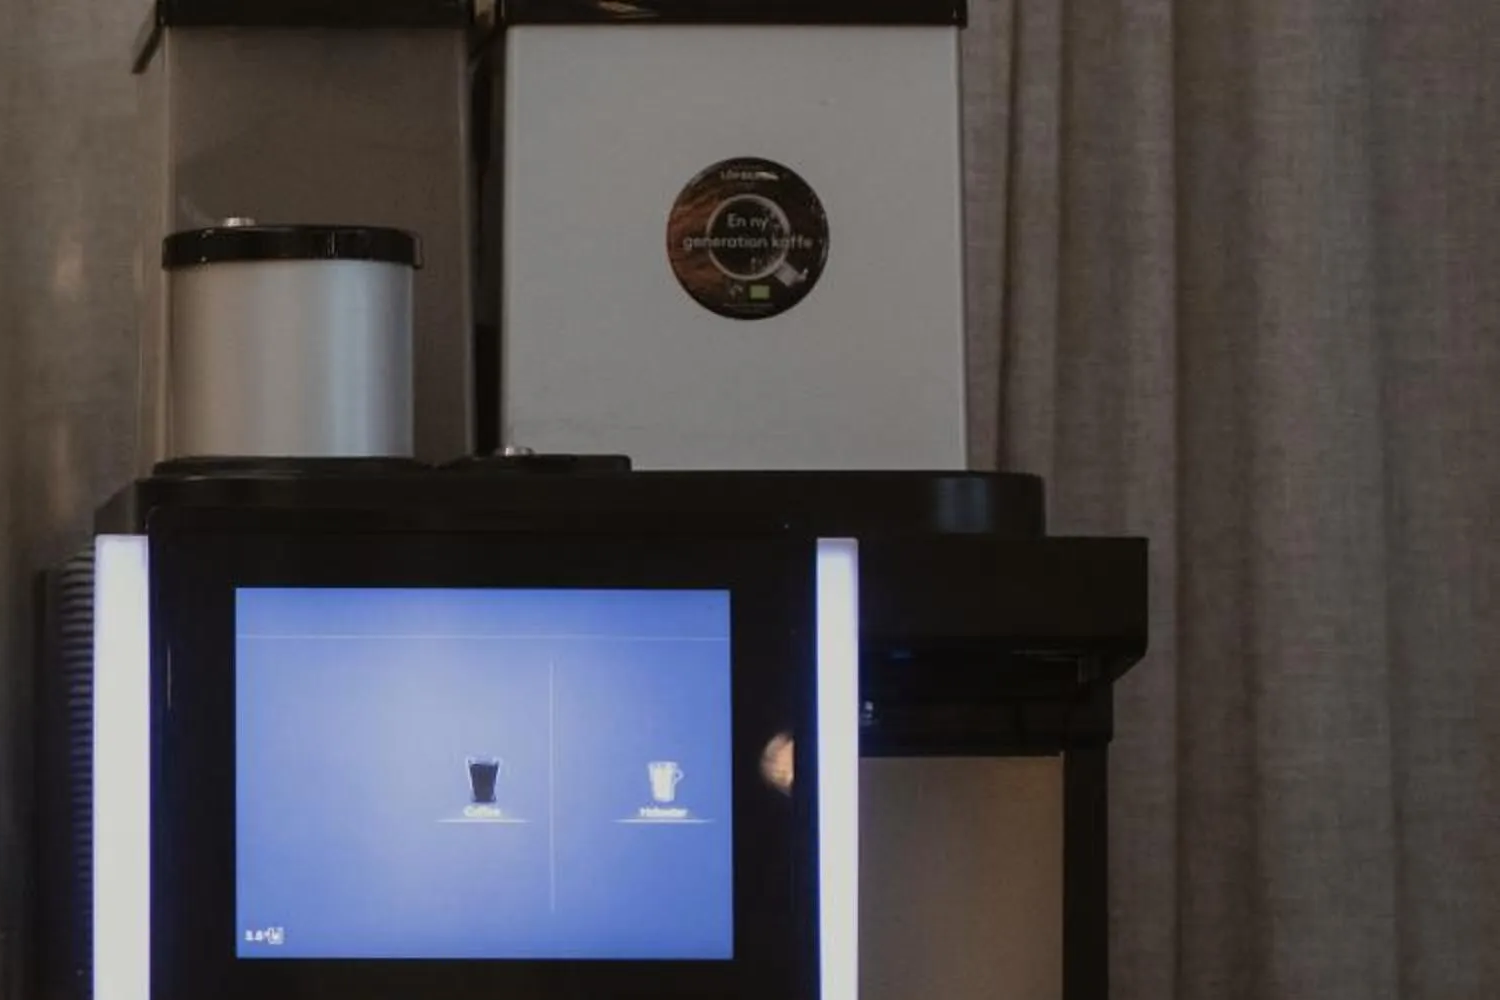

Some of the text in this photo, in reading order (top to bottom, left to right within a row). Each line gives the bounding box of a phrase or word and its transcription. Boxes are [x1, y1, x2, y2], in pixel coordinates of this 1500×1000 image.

[727, 213, 770, 231] En ny
[683, 234, 813, 252] generation kaffe
